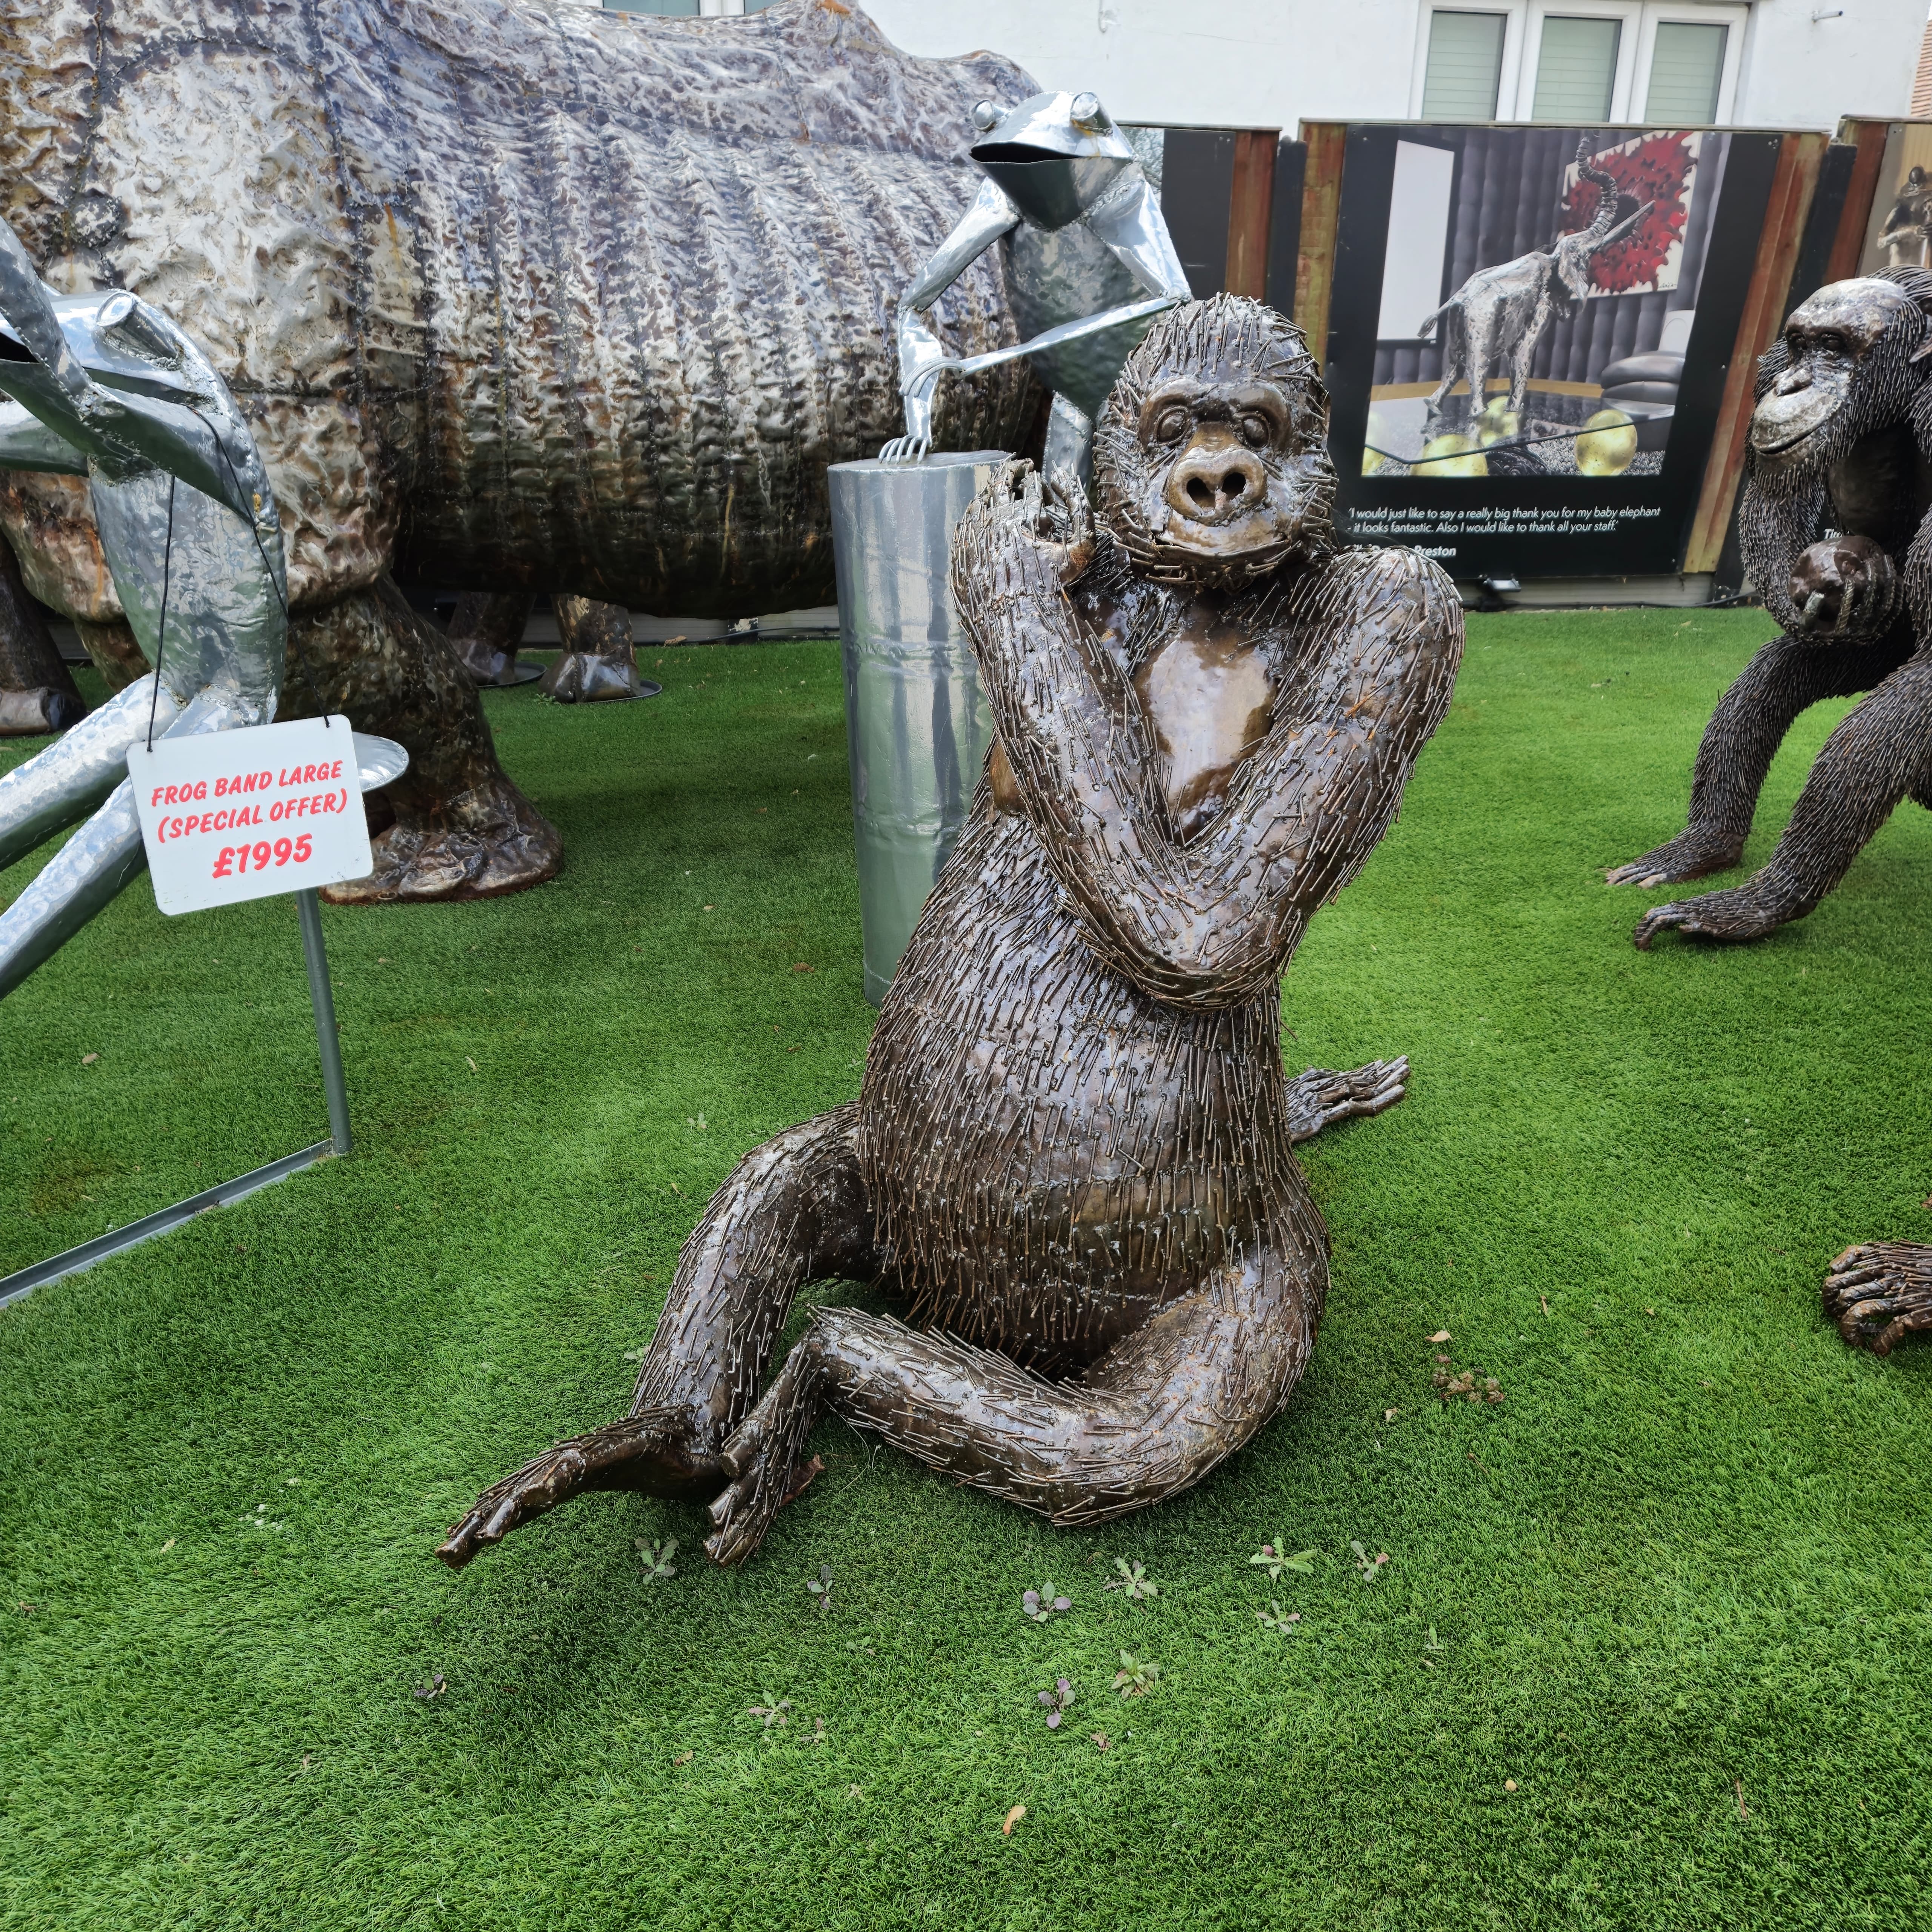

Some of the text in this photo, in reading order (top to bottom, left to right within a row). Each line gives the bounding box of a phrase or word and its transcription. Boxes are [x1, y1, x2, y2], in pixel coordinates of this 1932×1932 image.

[1354, 521, 1361, 533] it
[1363, 521, 1389, 532] looks
[1390, 521, 1434, 532] fantastic.
[1435, 521, 1459, 532] Also
[1460, 521, 1464, 532] I
[1466, 521, 1497, 532] would
[1498, 520, 1514, 532] like
[1516, 522, 1527, 531] to
[1529, 520, 1555, 532] thank
[1557, 520, 1569, 531] all
[1569, 523, 1592, 534] your
[1357, 507, 1388, 518] would
[1388, 508, 1406, 521] just
[1408, 507, 1424, 518] like
[1427, 508, 1438, 518] to
[1439, 509, 1456, 521] say
[1457, 510, 1464, 518] a
[1466, 507, 1493, 521] really
[1495, 507, 1510, 520] big
[1512, 506, 1539, 518] thank
[1540, 509, 1560, 520] you
[1561, 506, 1576, 517] for
[1577, 509, 1592, 520] my
[1594, 506, 1618, 519] baby
[1619, 505, 1661, 519] elephant
[1414, 545, 1457, 556] Preston
[151, 760, 343, 807] FROG BAND LARGE
[158, 788, 348, 843] (SPECIAL OFFER)
[212, 833, 313, 878] £1995
